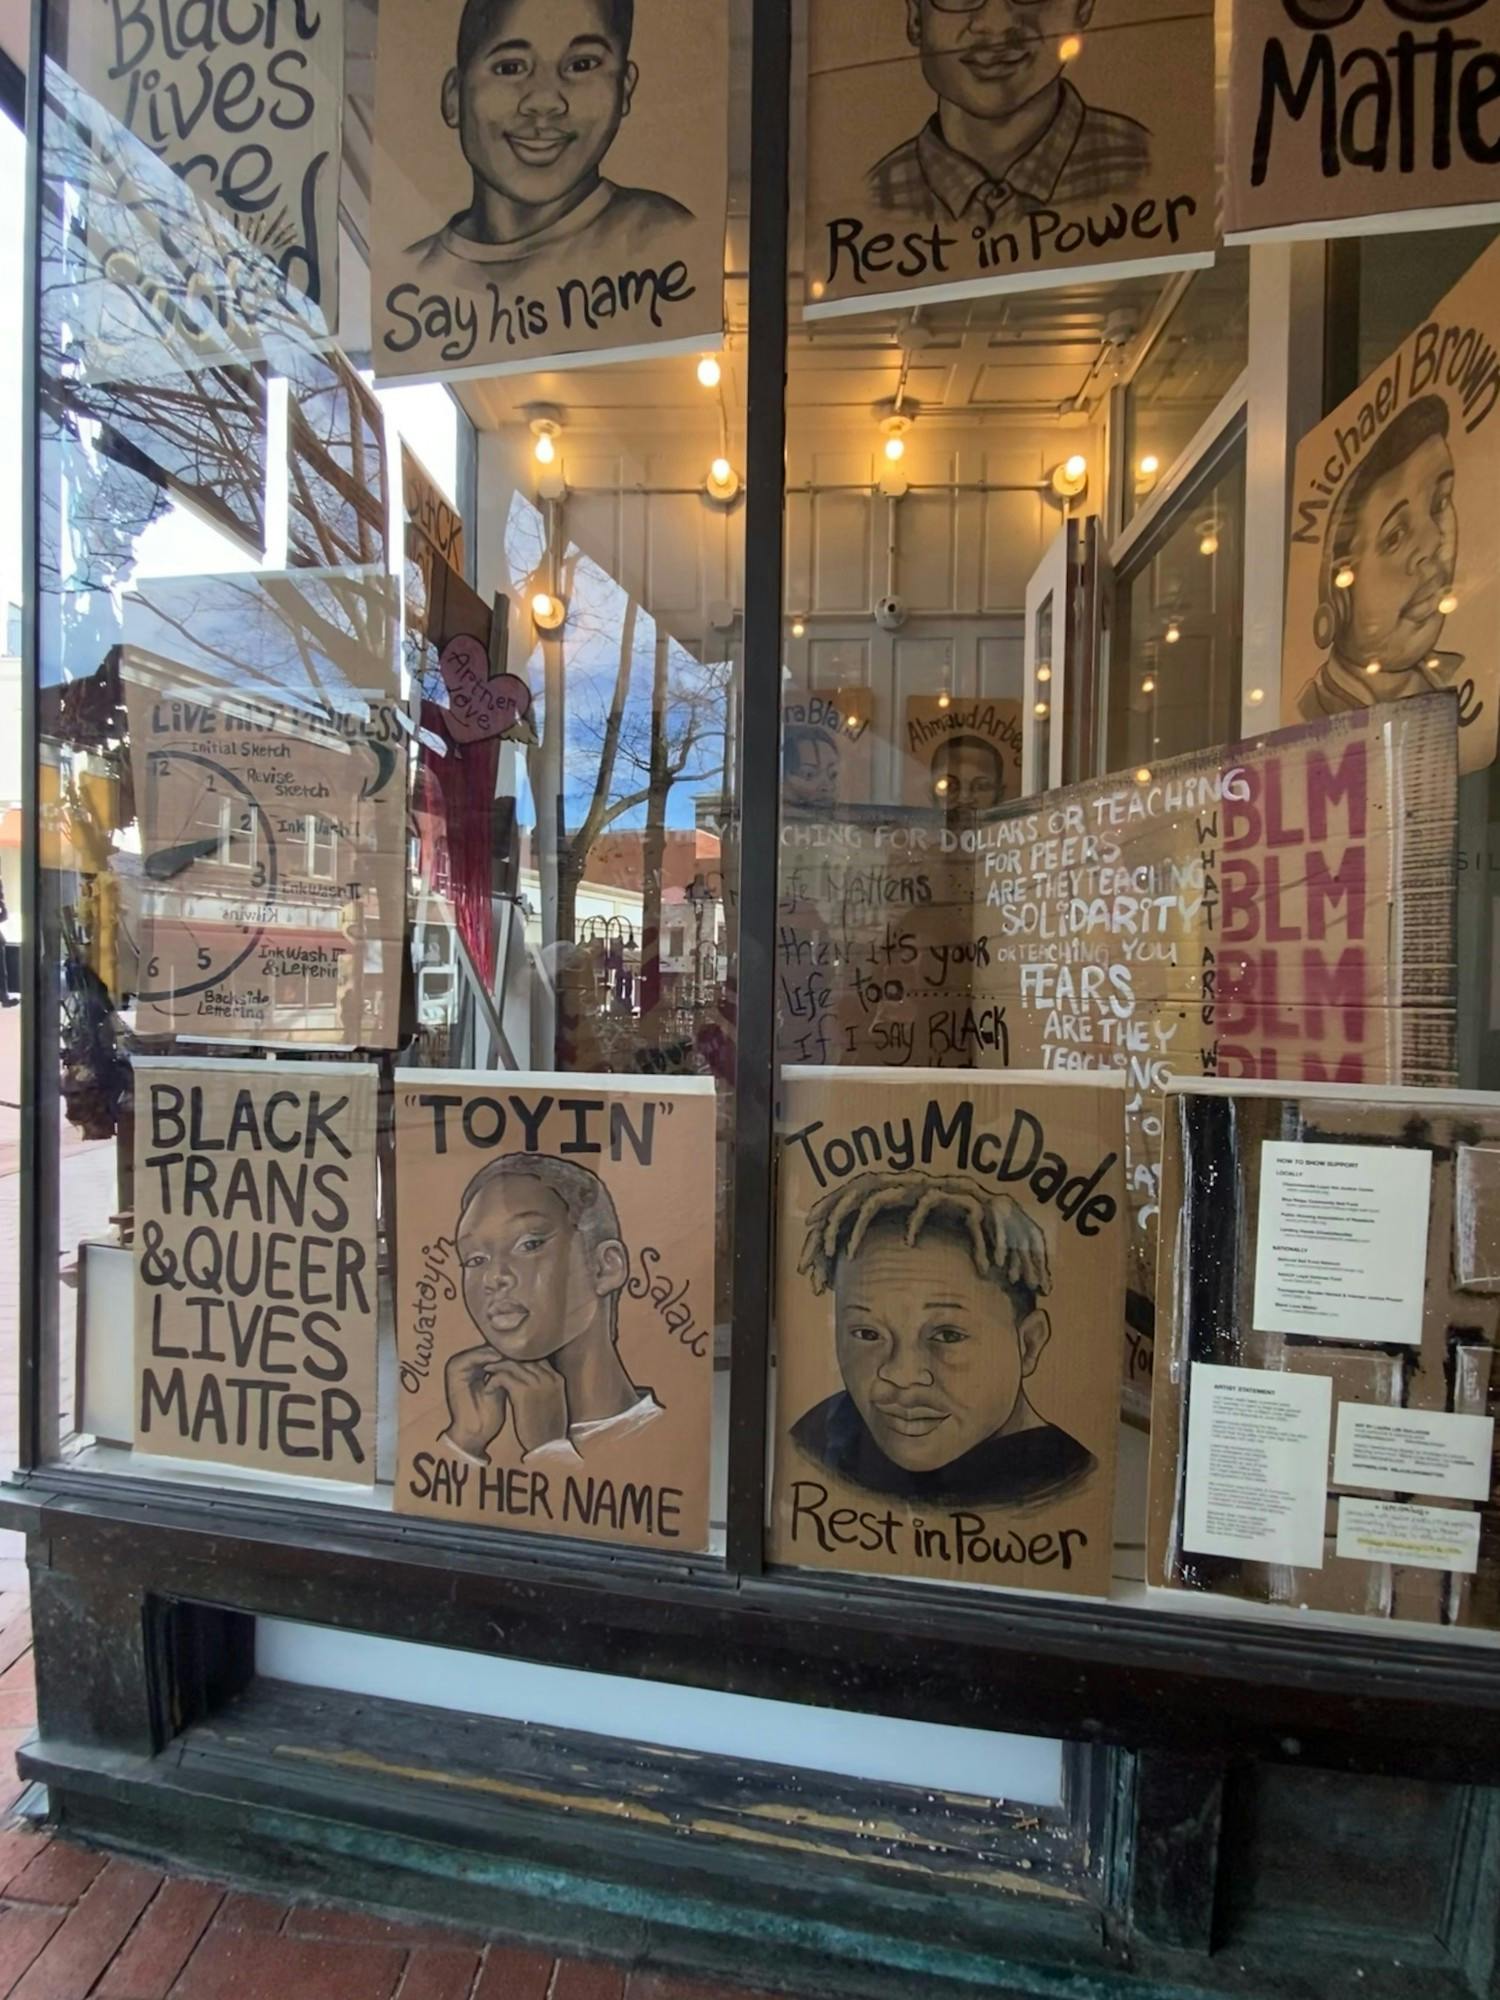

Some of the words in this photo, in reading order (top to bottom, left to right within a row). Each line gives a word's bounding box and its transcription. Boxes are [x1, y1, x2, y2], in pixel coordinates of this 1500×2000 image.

[826, 216, 959, 285] Rest
[976, 229, 1020, 272] in
[1024, 194, 1197, 262] Power
[384, 281, 478, 361] Say
[489, 284, 550, 346] his
[560, 259, 698, 328] name
[1292, 354, 1400, 545] Michael
[909, 704, 978, 752] Ahmaud
[240, 814, 252, 831] 2
[874, 826, 928, 849] FOR
[940, 813, 1038, 853] DOLLARS
[1048, 804, 1086, 834] OR
[1222, 740, 1368, 853] BLM
[251, 861, 266, 888] 3
[985, 850, 1022, 877] FOR
[1029, 831, 1122, 872] PEERS
[986, 876, 1028, 907] ARE
[1032, 868, 1084, 899] THEY
[1195, 810, 1219, 931] WHAT
[1220, 845, 1367, 944] BLM
[147, 957, 159, 978] 6
[198, 947, 212, 970] 5
[997, 946, 1017, 962] OR
[1122, 937, 1178, 962] YOU
[204, 988, 269, 1006] Backside
[1019, 963, 1136, 1018] FEARS
[1215, 945, 1368, 1043] BLM
[793, 1014, 838, 1065] If
[871, 1021, 915, 1066] SAY
[929, 1005, 1009, 1067] BLACK
[1043, 1010, 1094, 1042] ARE
[1097, 1018, 1178, 1054] THEY
[151, 1084, 352, 1160] BLACK
[145, 1152, 350, 1233] TRANS
[785, 1118, 911, 1188] Tony
[920, 1099, 1118, 1237] McDade
[151, 1293, 348, 1382] LIVES
[400, 1236, 455, 1394] Oluwatoyin
[628, 1247, 706, 1358] Salau
[140, 1367, 365, 1463] MATTER
[410, 1451, 469, 1507] SAY
[479, 1463, 553, 1520] HER
[563, 1475, 684, 1537] NAME
[789, 1481, 903, 1554] Rest
[911, 1517, 949, 1560] in
[949, 1512, 1088, 1570] Power
